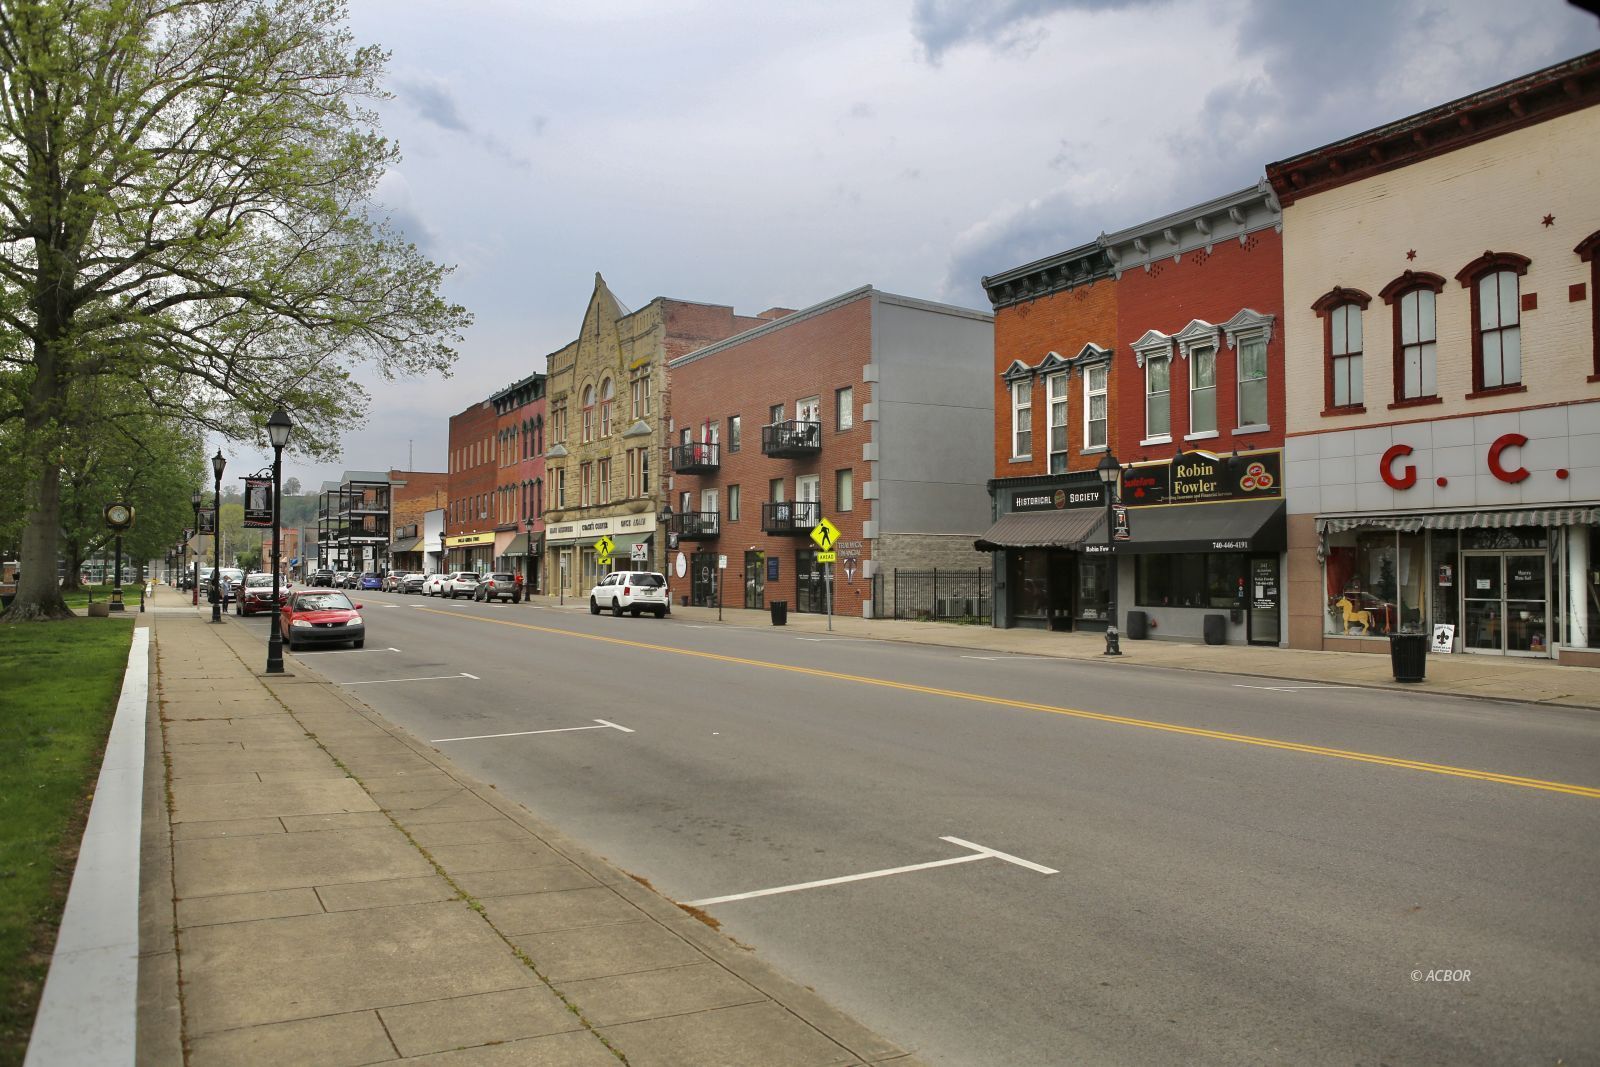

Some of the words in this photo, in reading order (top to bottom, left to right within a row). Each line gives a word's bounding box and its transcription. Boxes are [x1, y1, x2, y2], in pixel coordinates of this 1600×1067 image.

[1176, 462, 1214, 478] Robin
[1174, 479, 1217, 495] Fowler
[1016, 496, 1052, 507] HISTORICAL
[1069, 492, 1099, 503] SOCIETY
[1212, 541, 1248, 549] 740-446-4191
